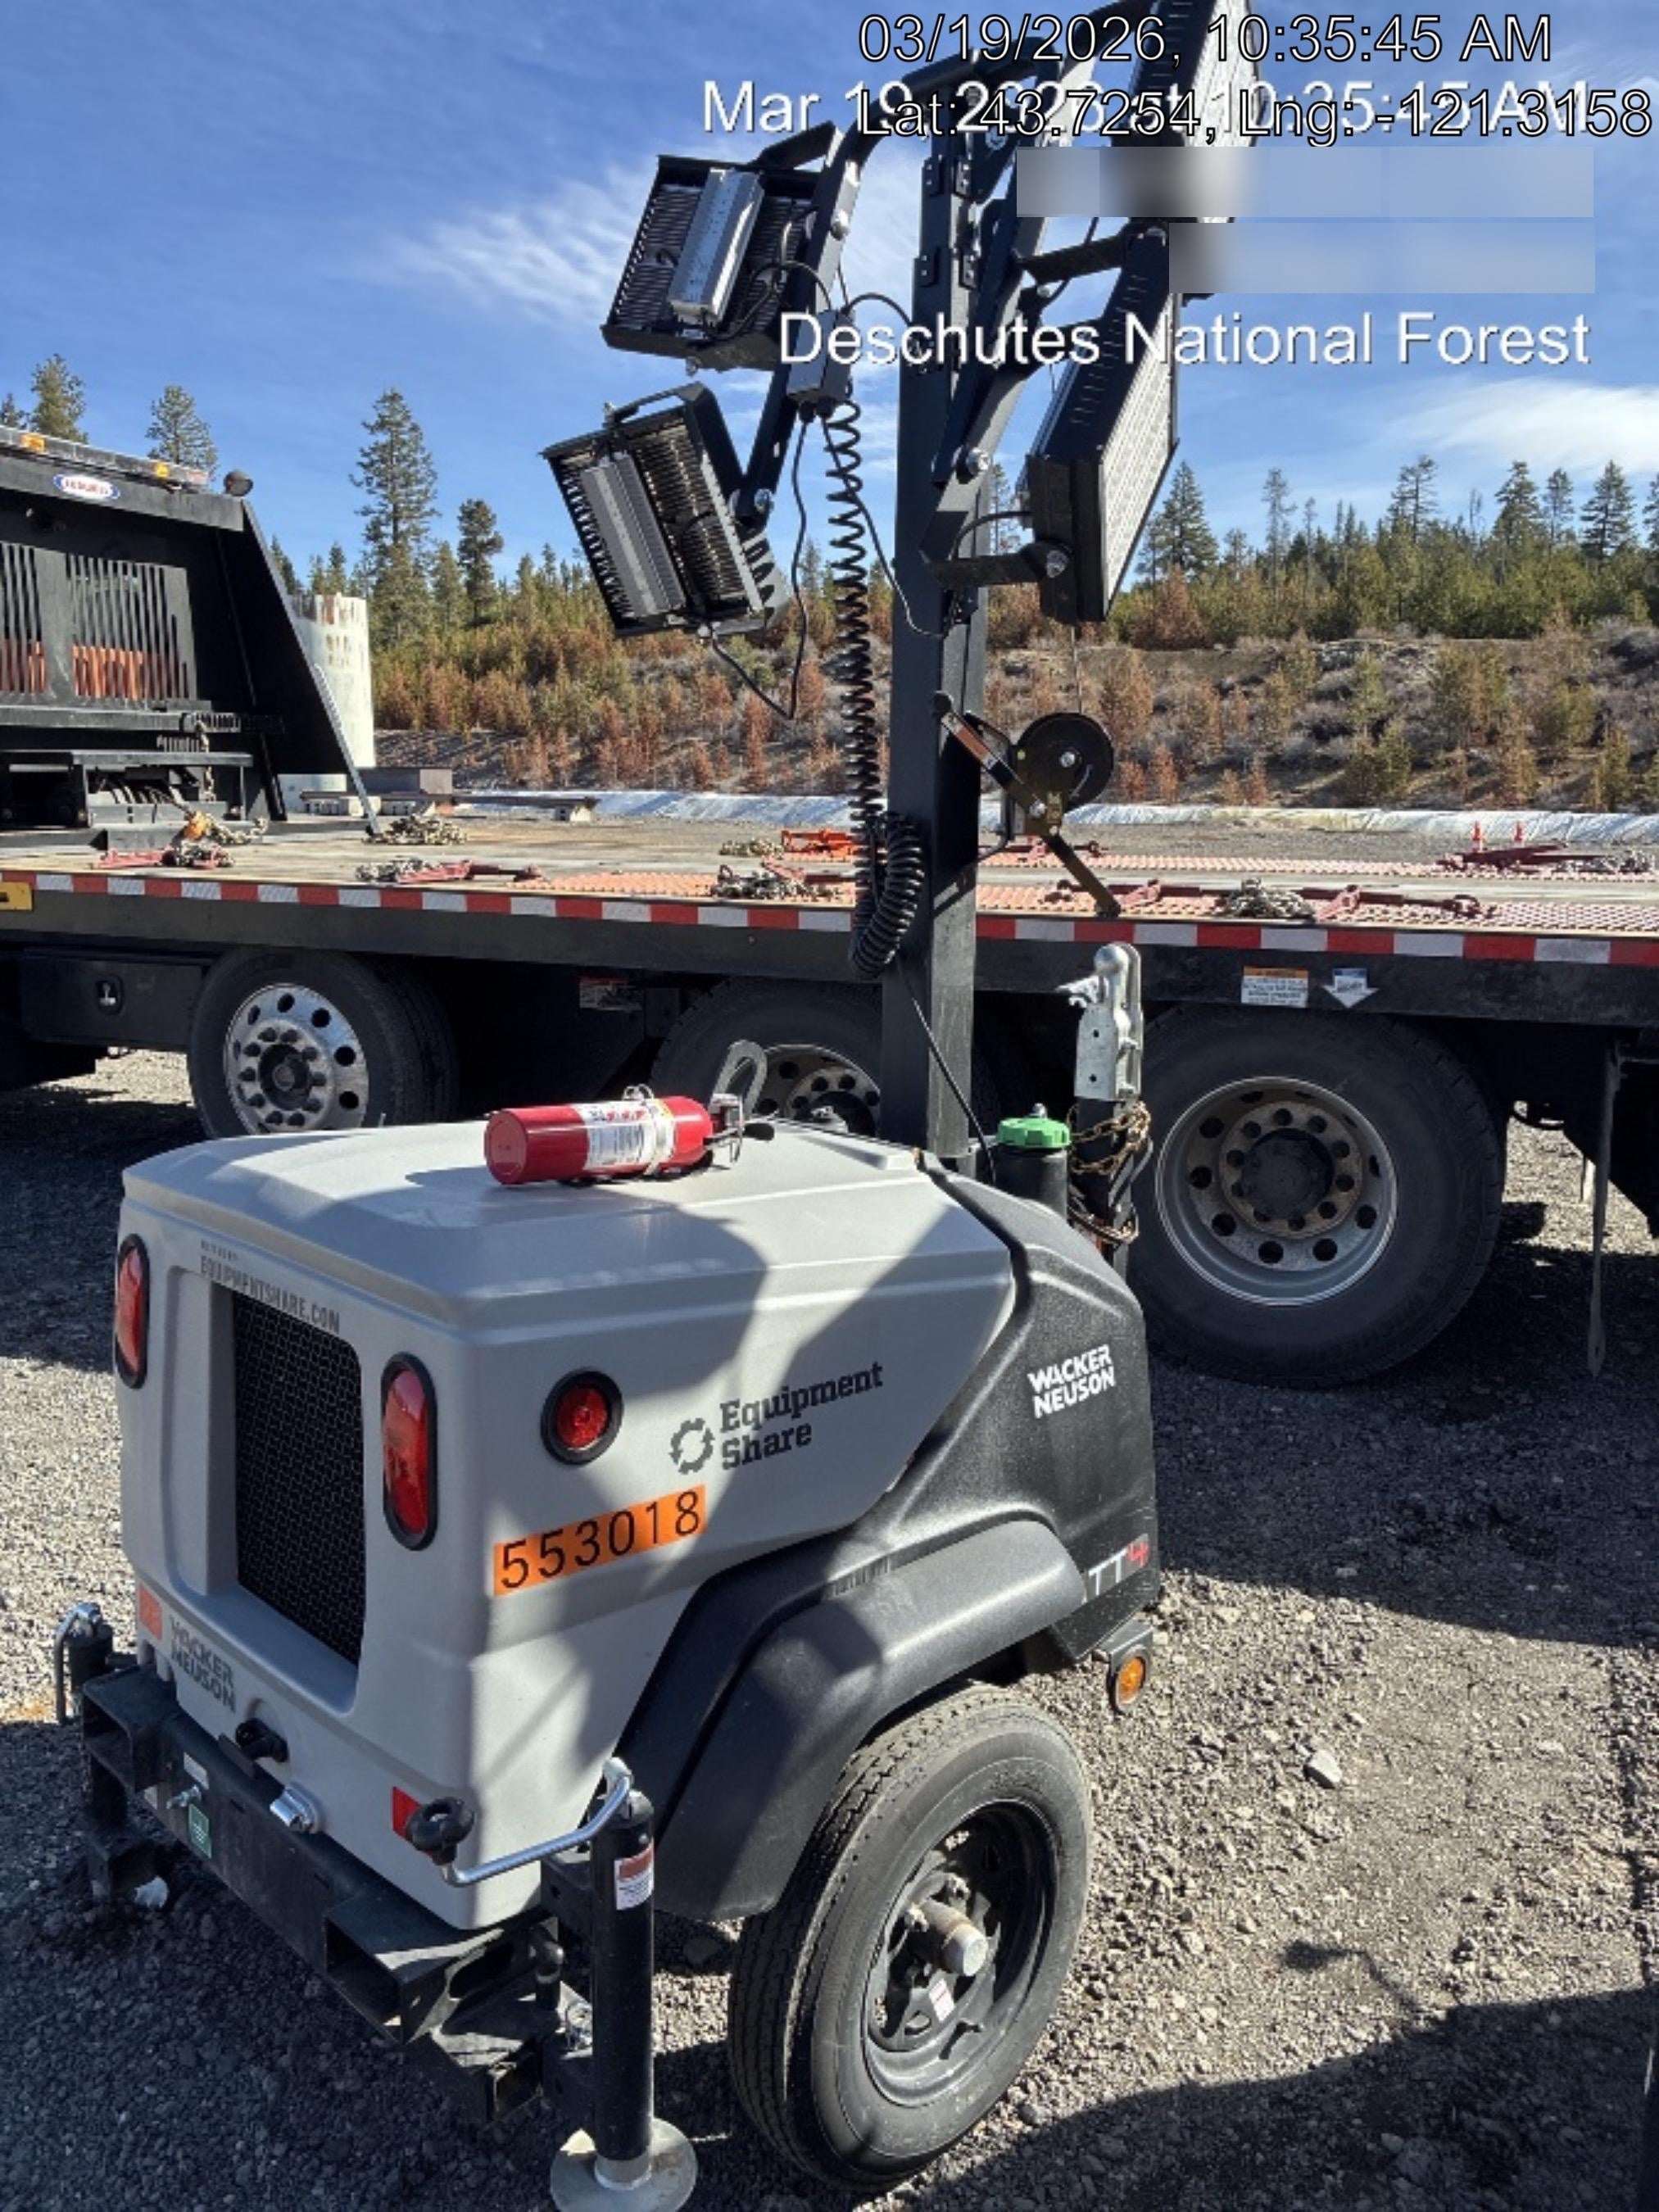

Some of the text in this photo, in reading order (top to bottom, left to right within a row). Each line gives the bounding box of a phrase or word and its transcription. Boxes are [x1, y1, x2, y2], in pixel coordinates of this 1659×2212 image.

[1027, 1344, 1114, 1394] WACKER
[1033, 1365, 1117, 1419] NEUSON
[719, 1361, 884, 1434] Equipment
[721, 1421, 813, 1471] Share
[501, 1489, 702, 1589] 553018
